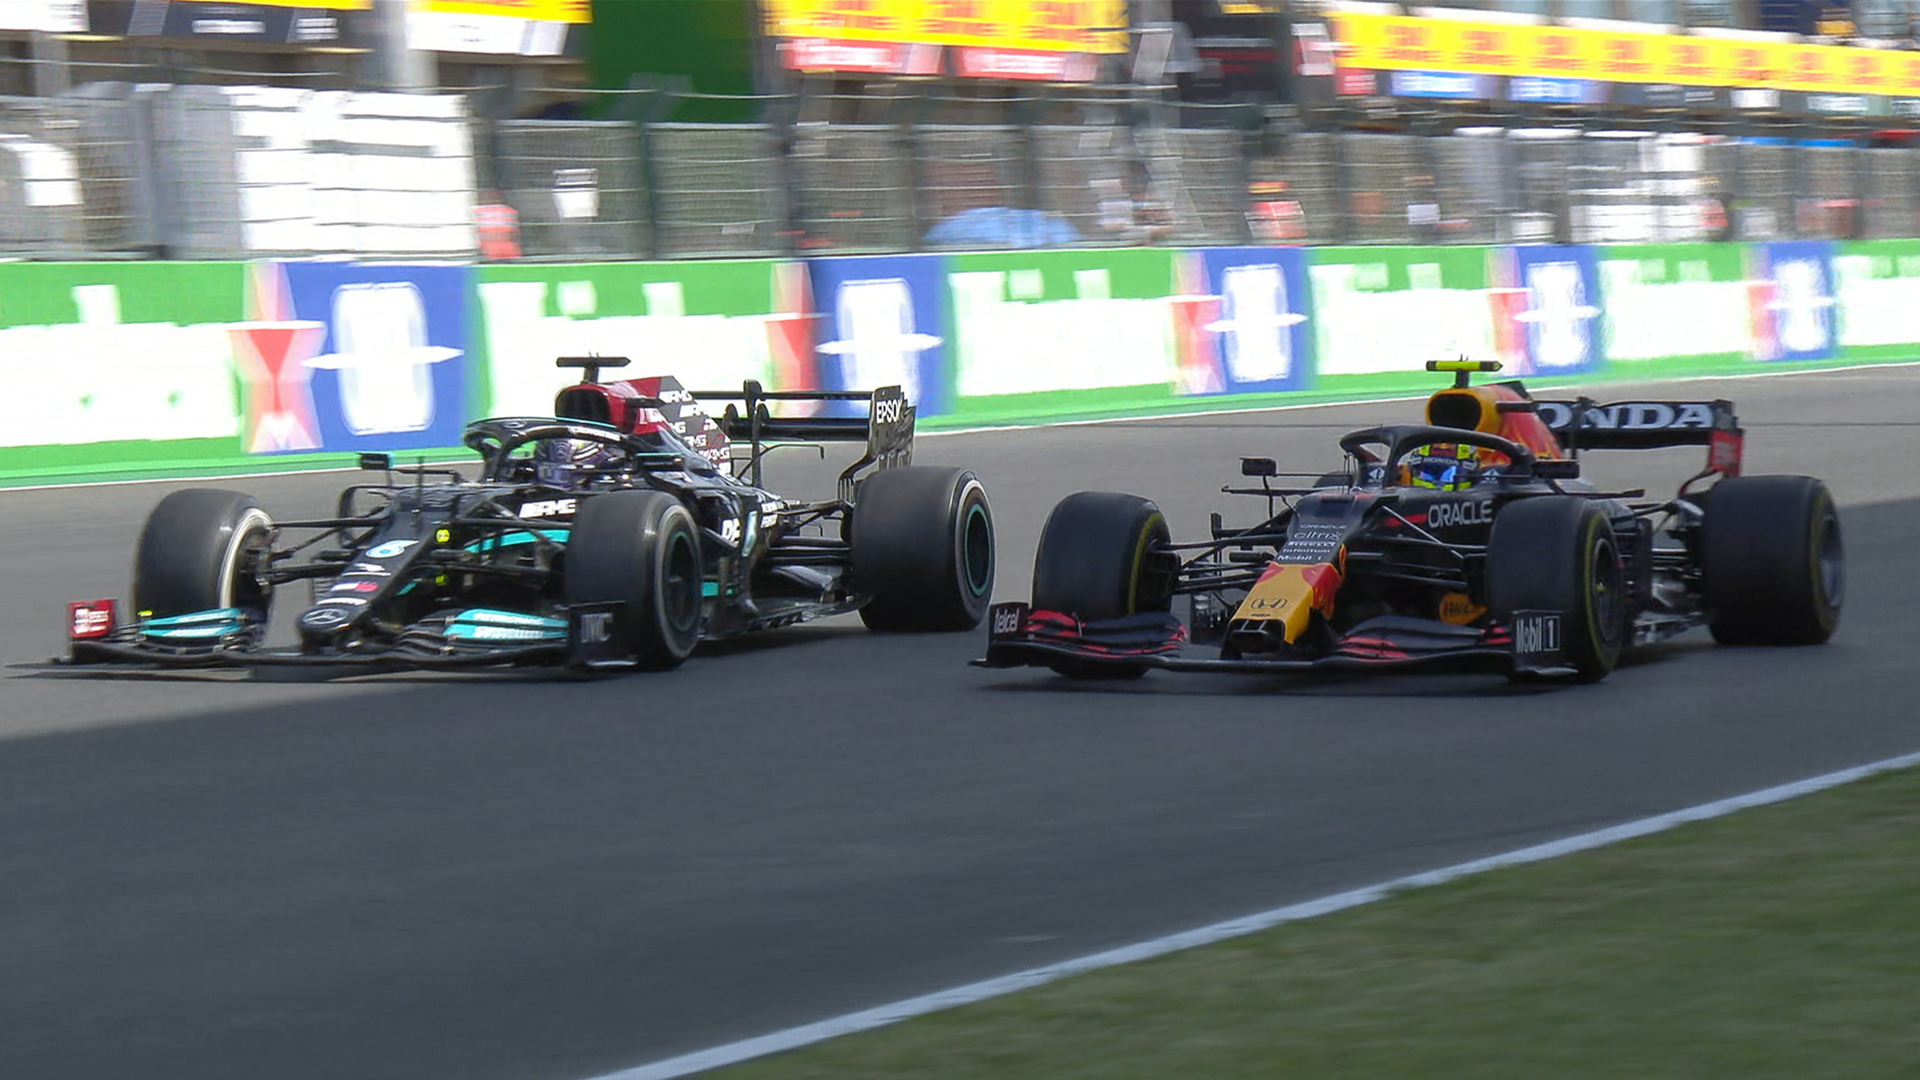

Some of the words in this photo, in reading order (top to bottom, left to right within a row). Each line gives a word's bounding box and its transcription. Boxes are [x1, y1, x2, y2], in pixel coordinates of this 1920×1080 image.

[876, 399, 901, 424] EPSO
[1537, 402, 1715, 429] ONDA
[1422, 456, 1460, 466] HONDA
[1428, 499, 1493, 528] ORACLE
[994, 608, 1020, 634] telcel
[1516, 617, 1542, 654] Mobil
